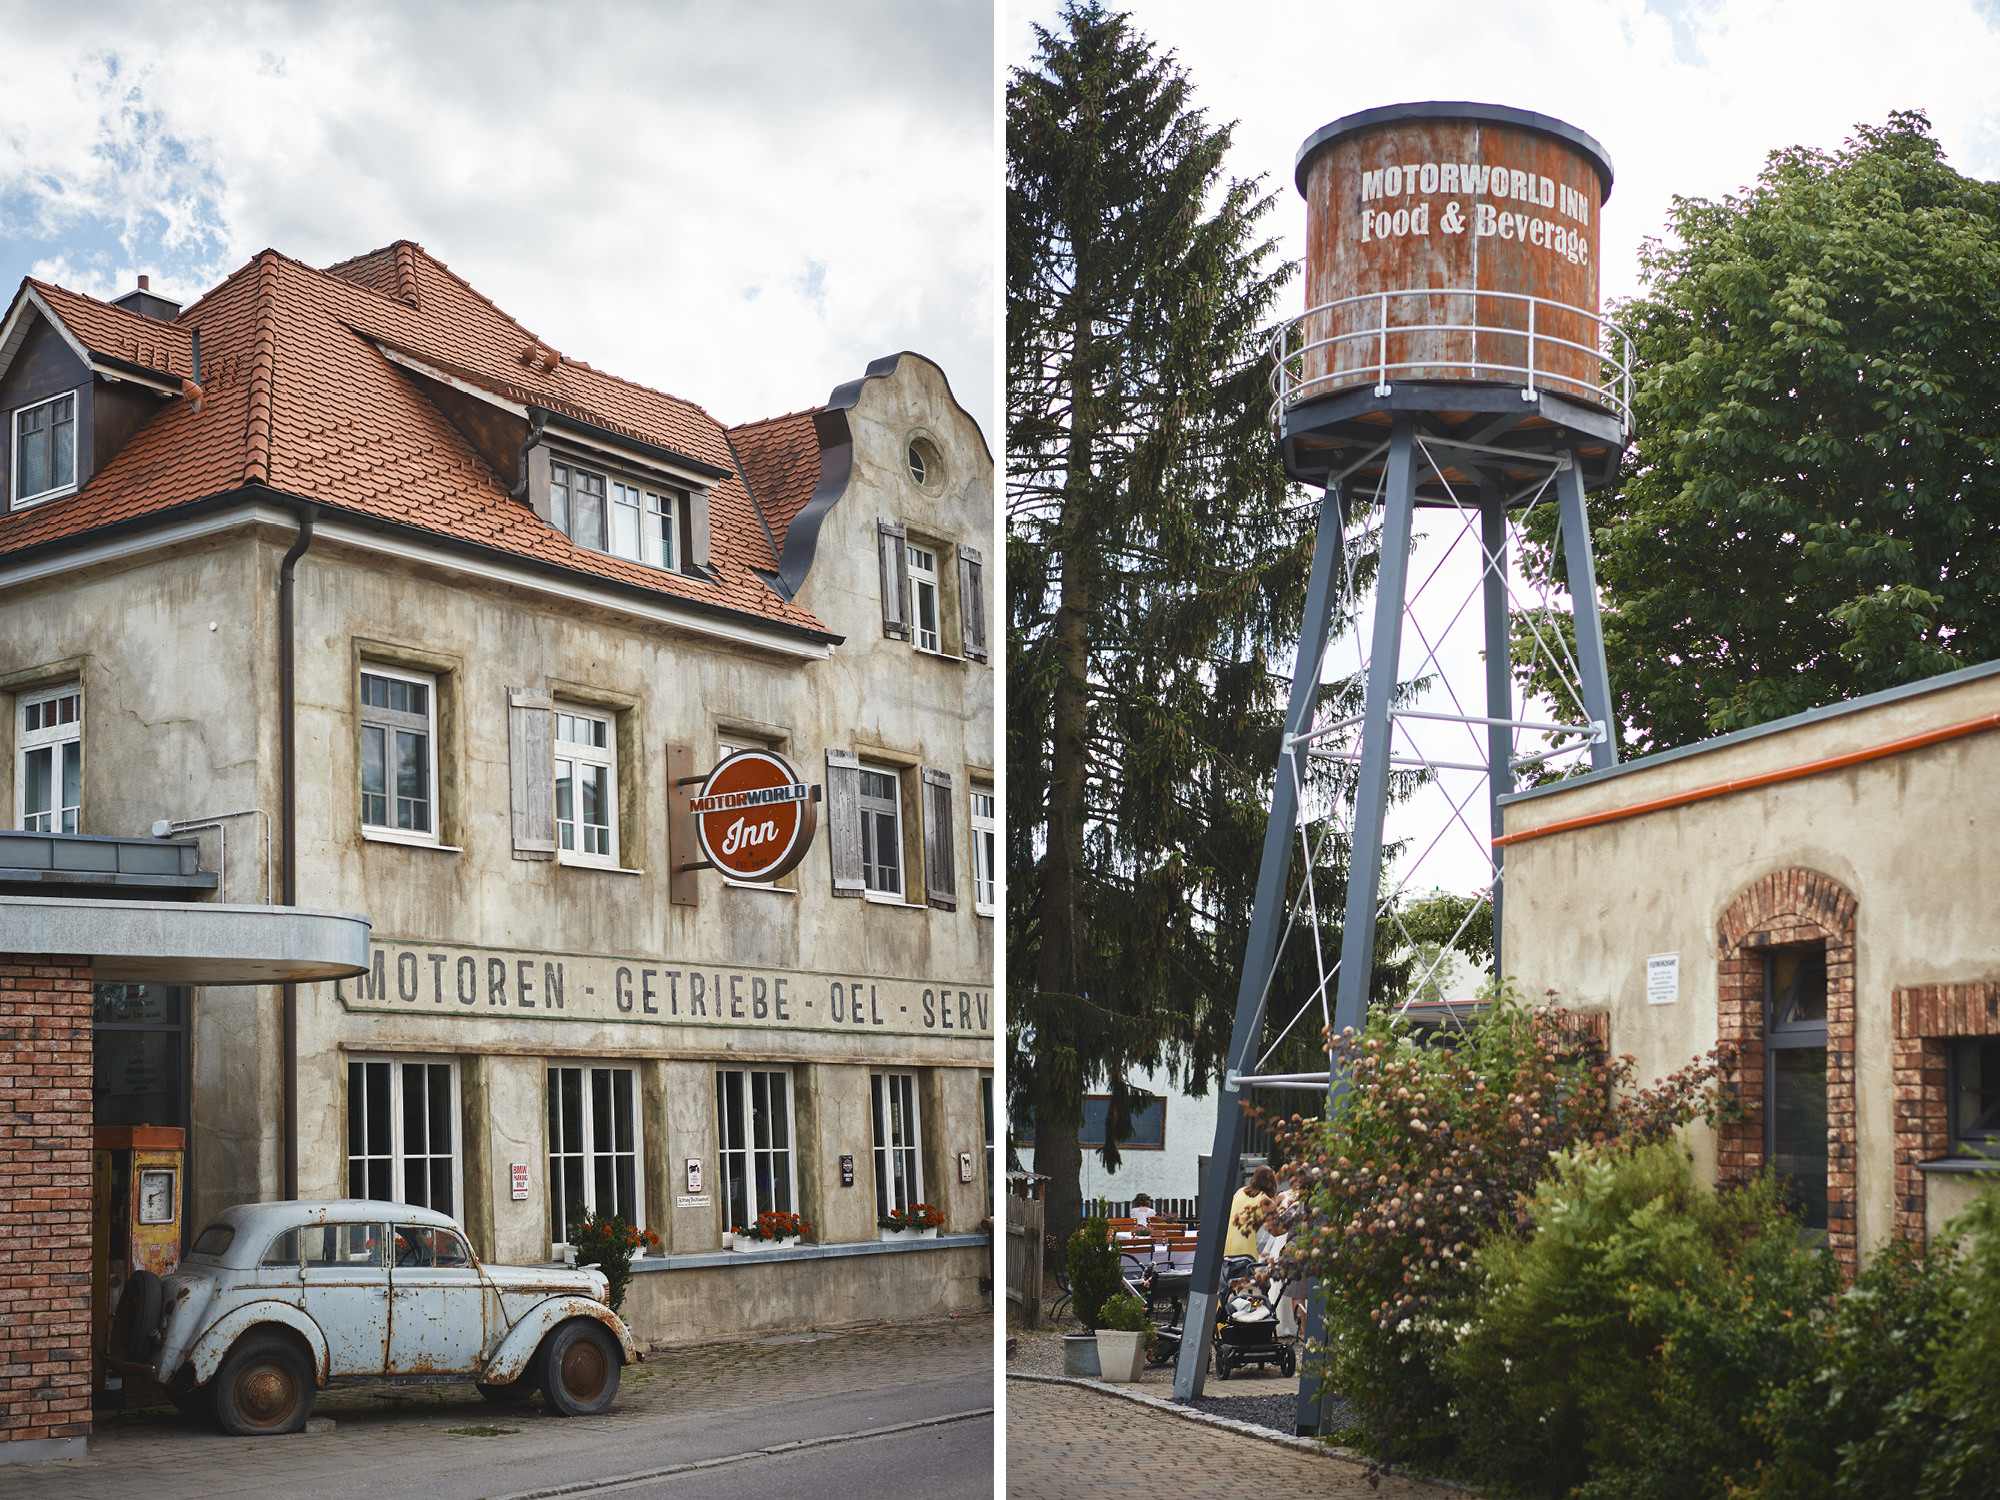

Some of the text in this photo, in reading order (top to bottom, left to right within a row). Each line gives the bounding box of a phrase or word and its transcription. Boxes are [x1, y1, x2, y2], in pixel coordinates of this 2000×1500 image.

[1362, 163, 1588, 226] MOTORWORLD INN
[1361, 201, 1588, 266] Food & Beverage
[690, 784, 806, 812] MOTORWORLD
[722, 816, 779, 855] Inn
[356, 950, 564, 1009] MOTOREN
[616, 966, 790, 1020] GETRIEBE
[830, 981, 884, 1025] OEL
[922, 989, 989, 1031] SERV
[513, 1165, 527, 1174] BMW
